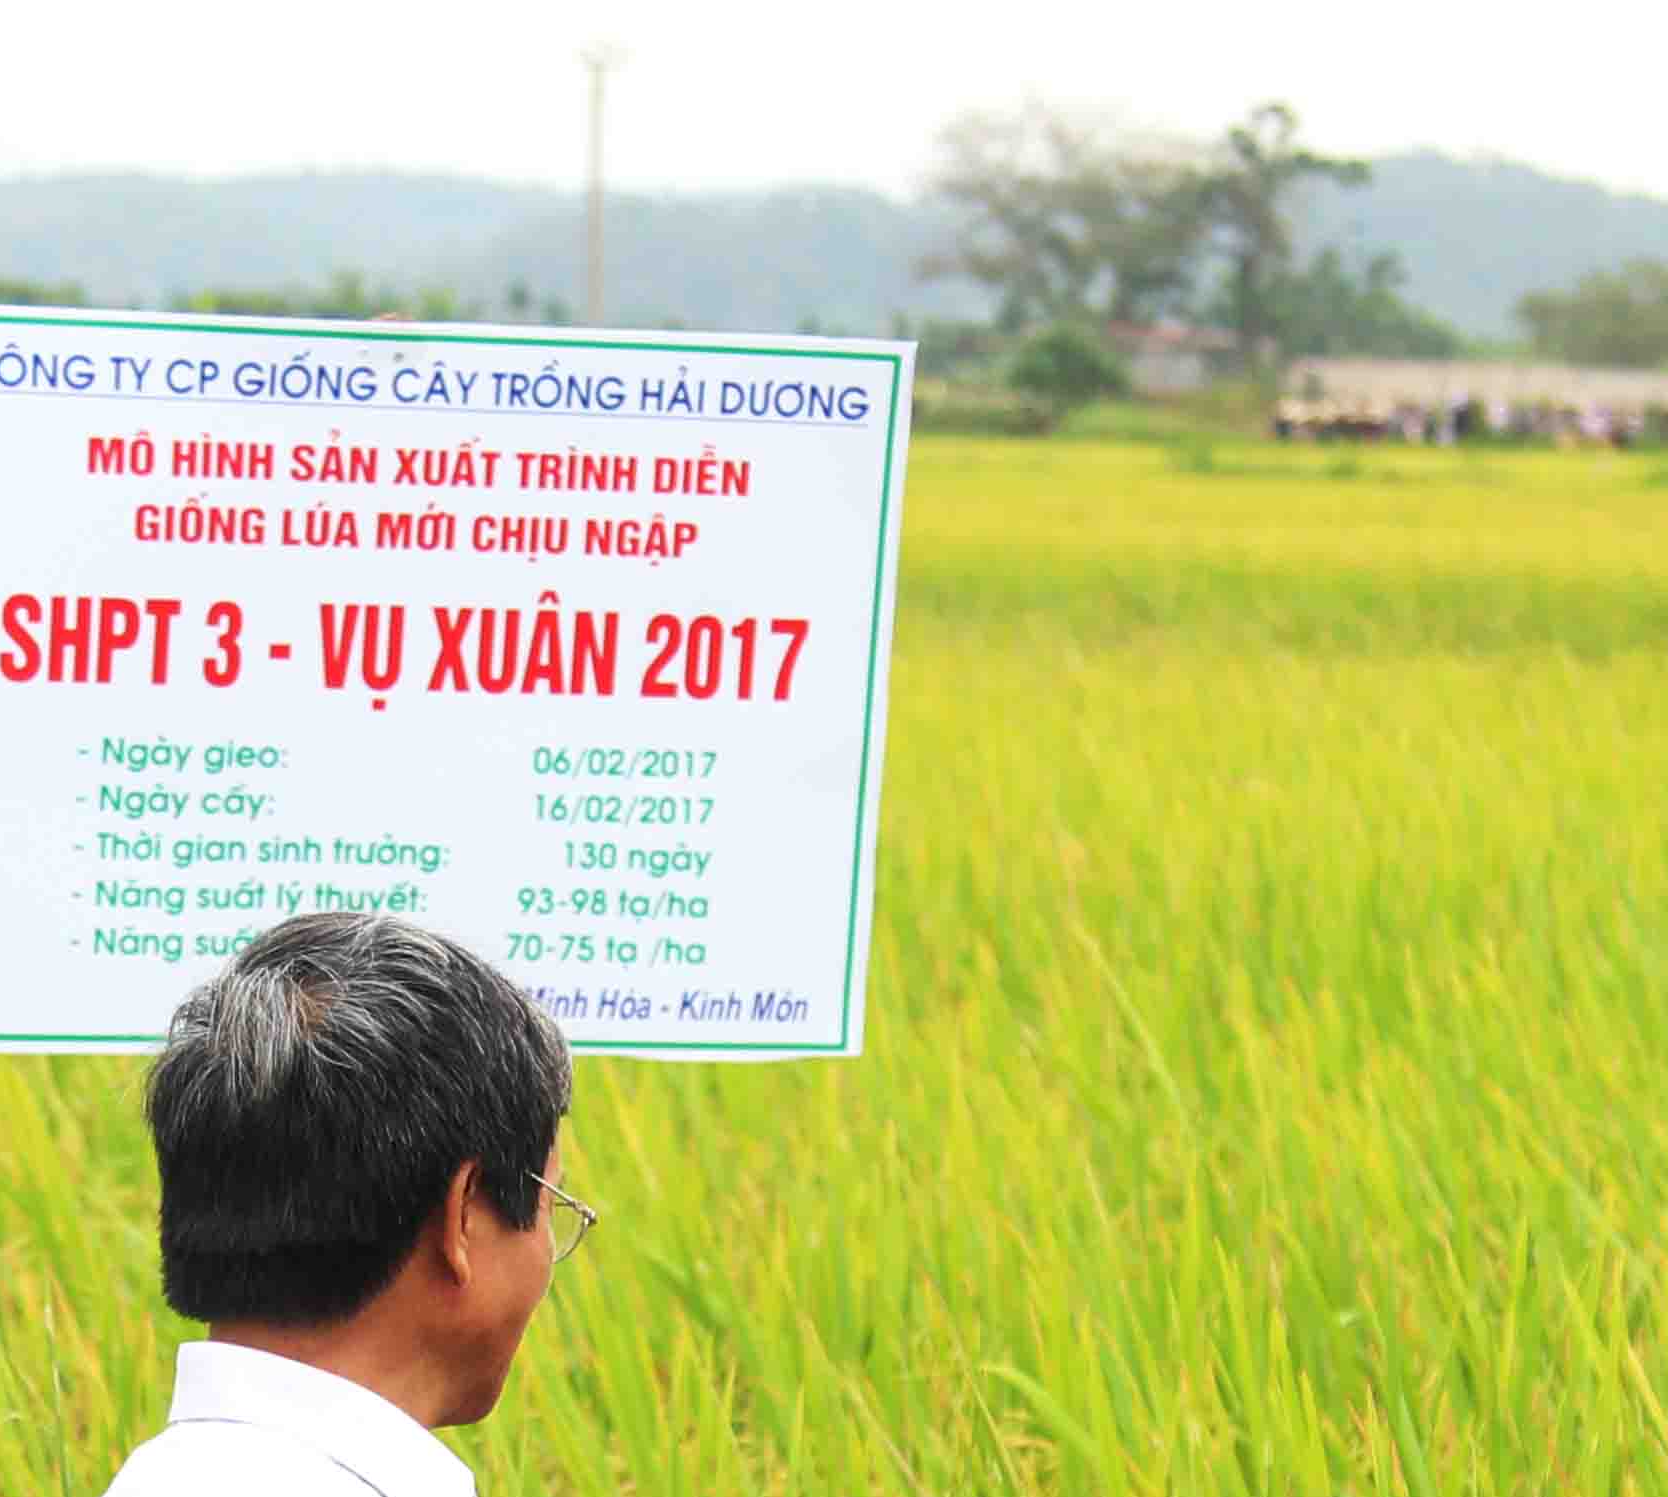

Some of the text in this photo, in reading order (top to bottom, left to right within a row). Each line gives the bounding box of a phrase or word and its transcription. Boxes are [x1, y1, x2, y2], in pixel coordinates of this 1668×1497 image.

[109, 356, 152, 393] TY
[165, 358, 220, 395] CP
[233, 350, 379, 402] GIỐNG
[392, 360, 479, 405] CÂY
[491, 359, 627, 411] TRỒNG
[639, 364, 706, 415] HẢI
[719, 380, 870, 420] DƯƠNG
[86, 427, 752, 497] MÔ HÌNH SẢN XUẤT TRÌNH DIỄN
[134, 490, 699, 568] GIỐNG LÚA MỚI CHỊU NGẬP
[202, 600, 243, 690] 3
[268, 640, 293, 660] -
[319, 602, 405, 711] VỤ
[427, 590, 620, 697] XUÂN
[640, 613, 811, 702] 2017
[101, 734, 194, 773] Ngày
[203, 739, 289, 775] gieo:
[532, 745, 718, 781] 06/02/2017
[99, 782, 190, 820] Ngày
[199, 780, 276, 821] cấy:
[534, 792, 716, 828] 16/02/2017
[97, 828, 163, 862] Thời
[171, 833, 247, 869] gian
[256, 834, 323, 864] sinh
[332, 832, 452, 873] trưởng:
[564, 840, 619, 870] 130
[627, 842, 713, 879] ngày
[95, 878, 187, 916] Năng
[196, 876, 266, 910] suất
[275, 880, 305, 914] lý
[313, 880, 430, 912] thuyết:
[515, 886, 607, 916] 93-98
[618, 892, 711, 923] tạ/ha
[92, 926, 184, 963] Năng
[194, 924, 256, 956] suấ
[504, 932, 597, 963] 70-75
[606, 937, 639, 972] tạ
[677, 989, 742, 1023] Kinh
